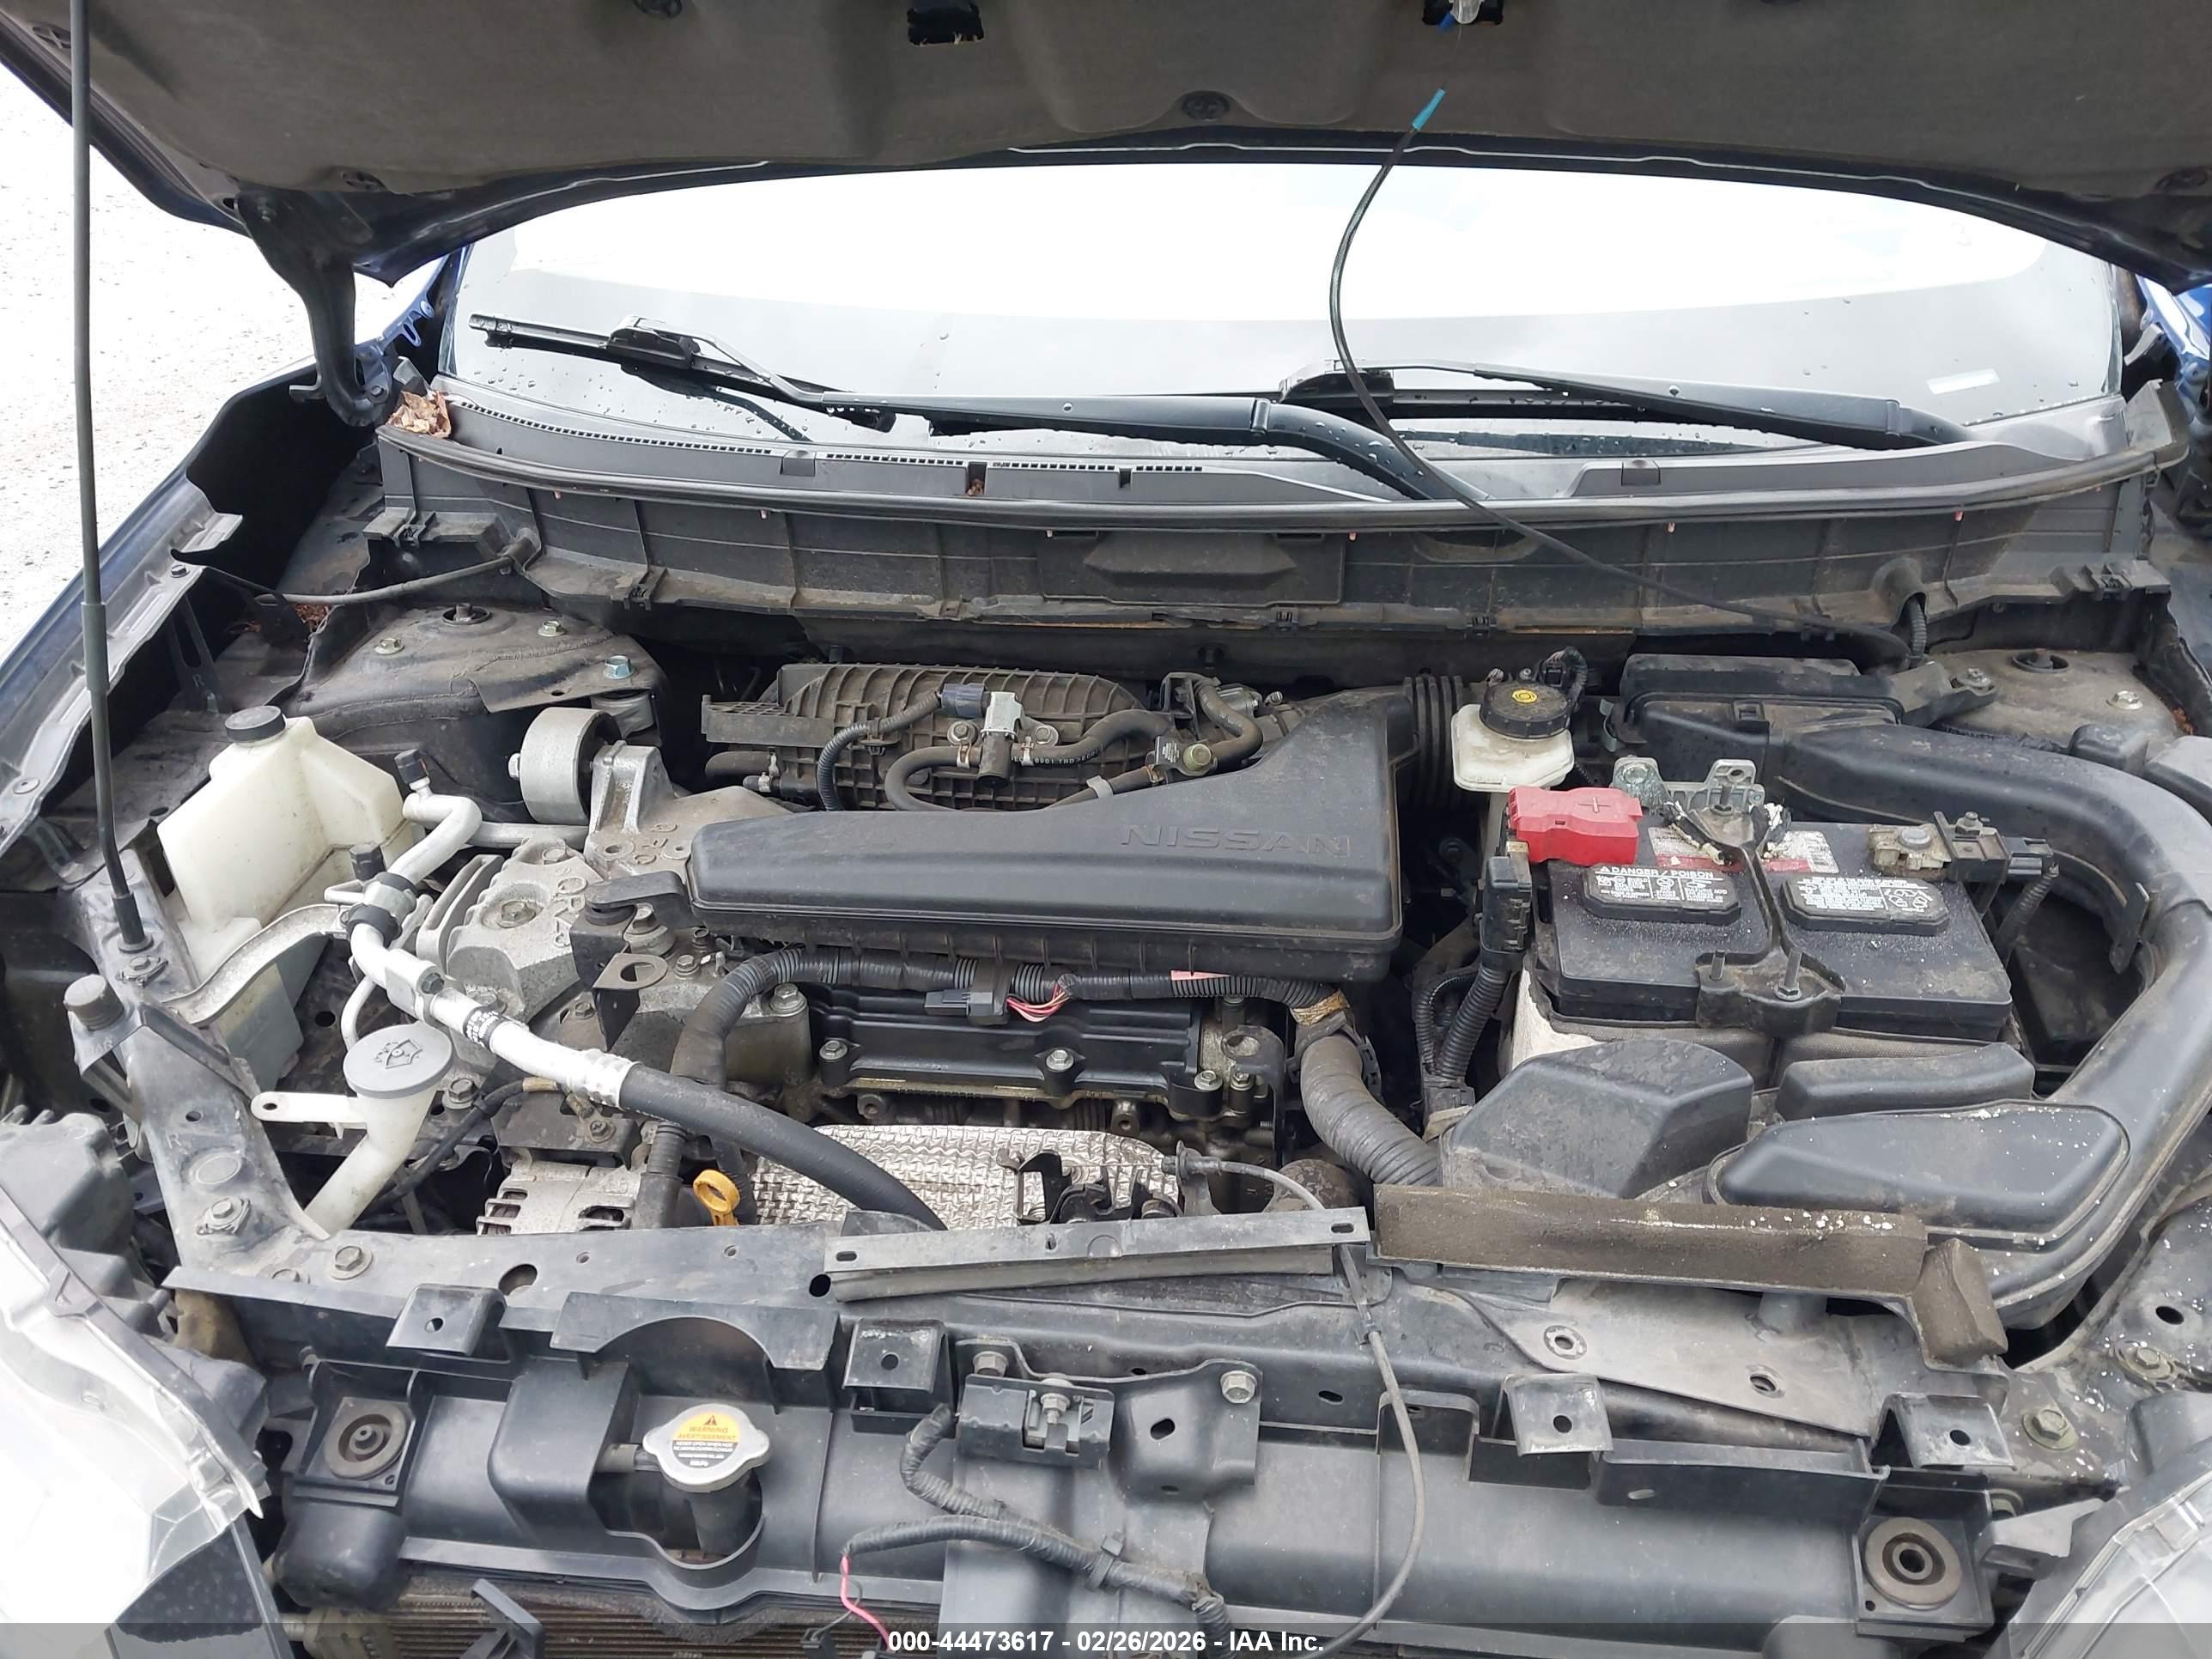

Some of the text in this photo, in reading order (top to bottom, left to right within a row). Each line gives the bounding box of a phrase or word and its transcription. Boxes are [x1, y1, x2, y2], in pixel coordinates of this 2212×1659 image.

[1121, 824, 1351, 857] NISSAN
[1611, 866, 1659, 876] DANGER
[1670, 869, 1713, 878] POISON
